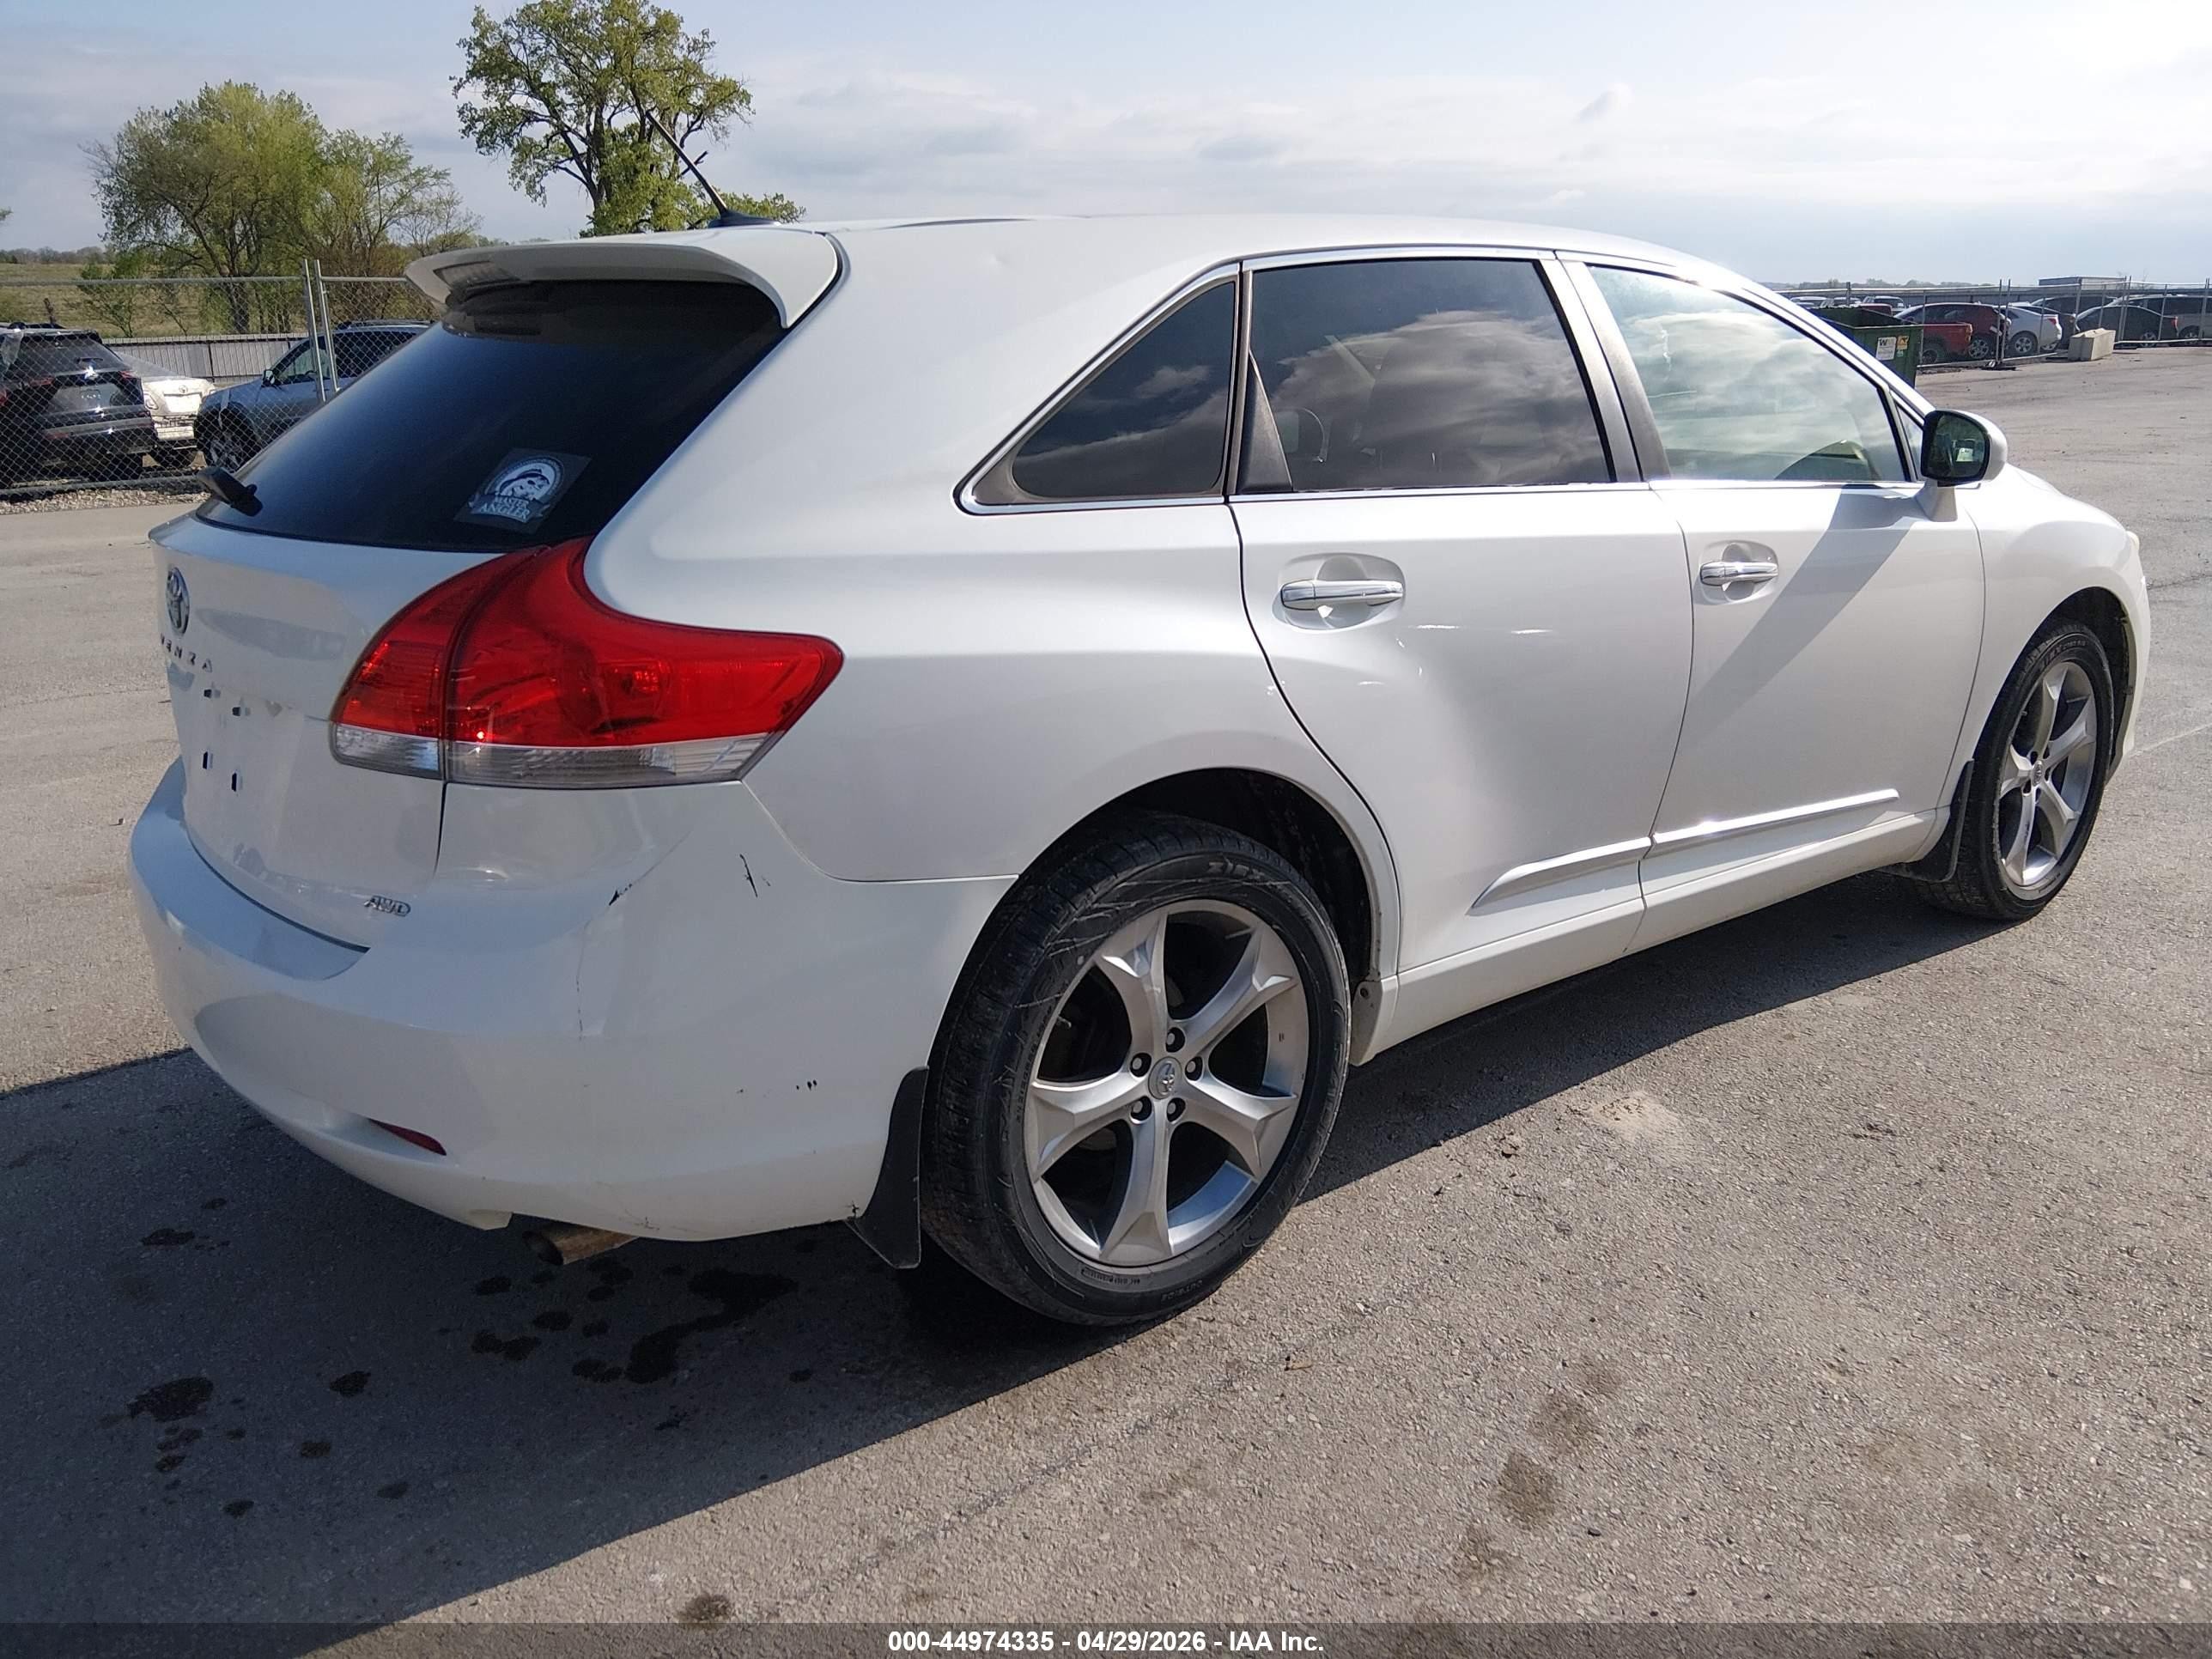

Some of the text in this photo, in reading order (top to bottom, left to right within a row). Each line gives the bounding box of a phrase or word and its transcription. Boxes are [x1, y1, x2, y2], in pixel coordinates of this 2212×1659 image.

[481, 502, 530, 520] ANGLER
[495, 496, 529, 509] MASTER
[364, 896, 411, 917] AWD
